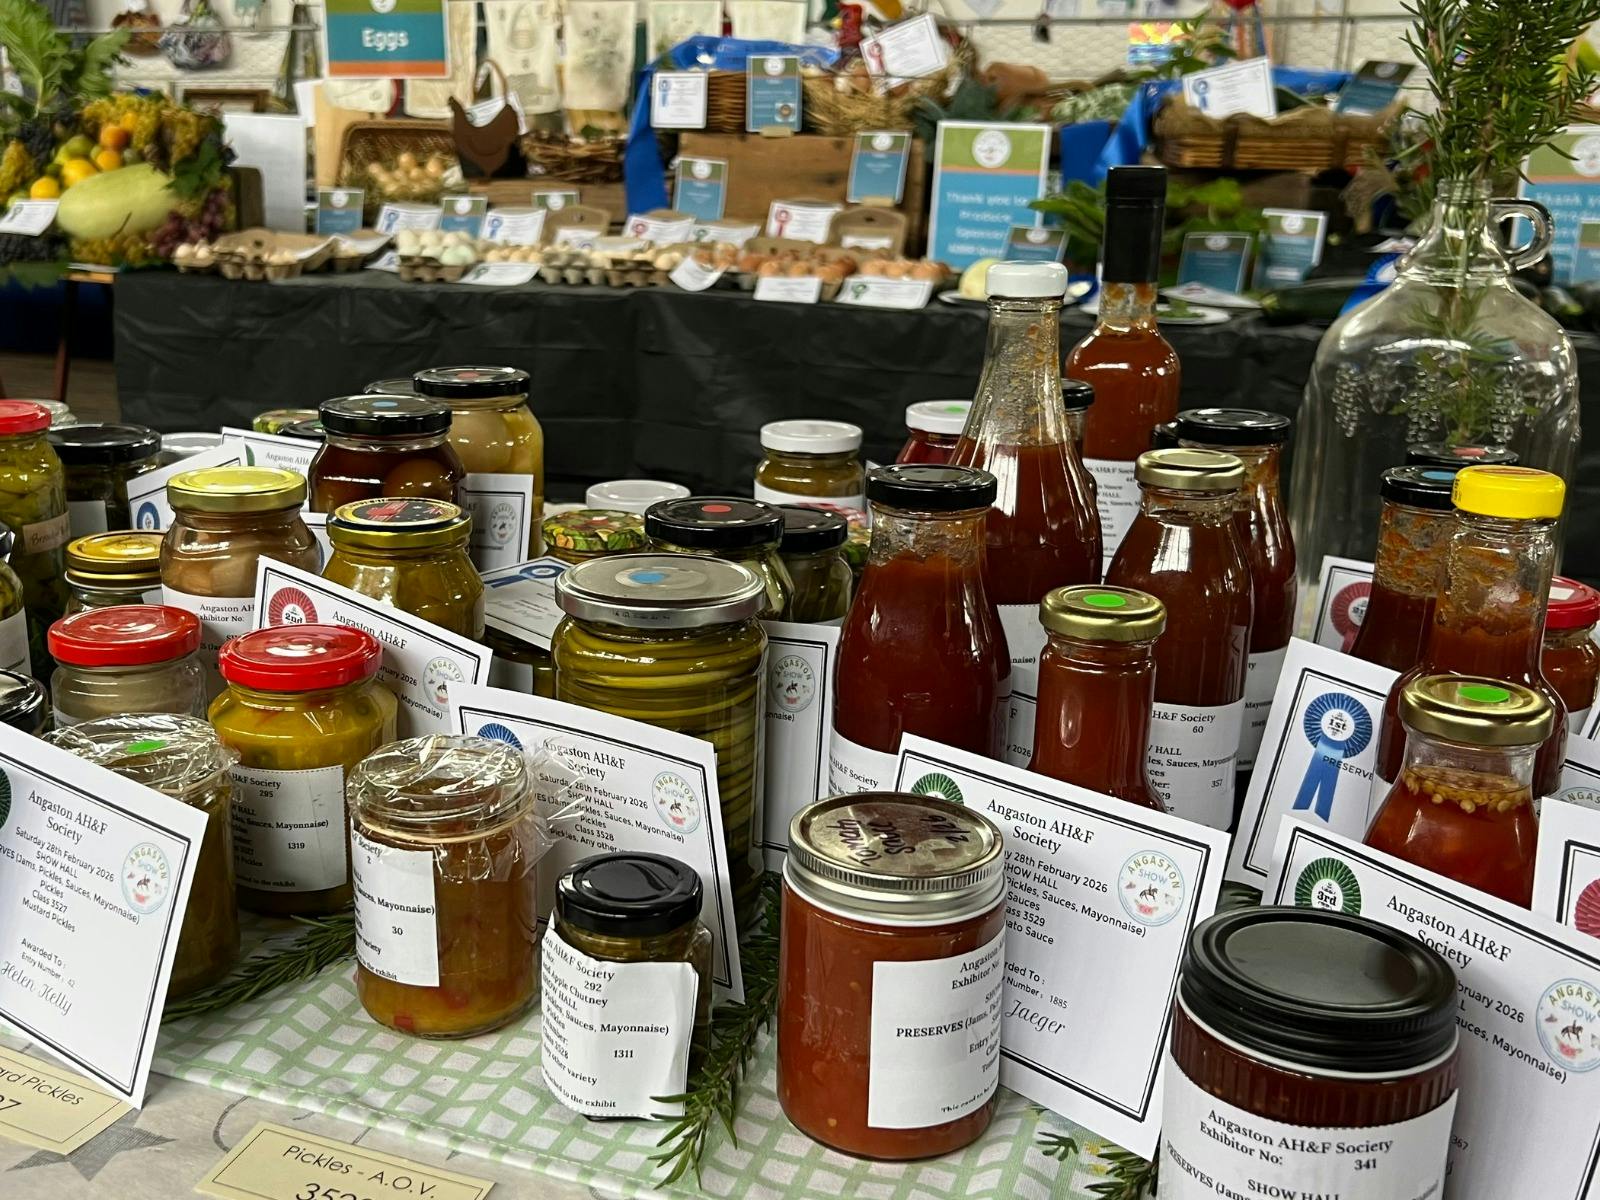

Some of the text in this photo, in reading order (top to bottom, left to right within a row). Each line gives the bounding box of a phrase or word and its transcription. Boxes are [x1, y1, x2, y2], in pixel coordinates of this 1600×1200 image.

[361, 28, 409, 51] Eggs
[199, 604, 255, 613] Angaston AH
[199, 614, 229, 622] xhibitor
[283, 613, 304, 624] 2nd
[331, 610, 408, 650] Angaston AH&F
[400, 672, 418, 687] 2026
[429, 660, 461, 680] ANGASTO
[774, 658, 812, 682] ANGASTON
[400, 693, 443, 720] Mayonnaise)
[1180, 713, 1216, 723] Society
[1192, 725, 1204, 734] 60
[1328, 718, 1348, 731] 1st
[542, 739, 626, 770] Angaston AH&F
[1012, 743, 1032, 757] 2026
[1155, 745, 1182, 756] HALL
[567, 757, 606, 782] Society
[1166, 759, 1200, 769] Sauces,
[250, 777, 282, 789] Society
[655, 776, 695, 802] ANGASTON
[849, 769, 879, 788] Society
[259, 789, 274, 798] 295
[567, 789, 615, 810] SHOW HALL
[575, 781, 593, 794] 28th
[594, 786, 628, 805] February
[629, 797, 649, 810] 2026
[28, 789, 109, 836] Angaston AH&F
[580, 814, 607, 829] Pickles
[986, 797, 1095, 845] Angaston AH&F
[46, 816, 84, 846] Society
[275, 819, 329, 832] Mayonnaise)
[575, 823, 615, 842] Class 3528
[604, 811, 634, 828] Sauces,
[635, 820, 685, 845] Mayonnaise)
[287, 842, 305, 850] 1319
[580, 836, 596, 848] Any
[597, 842, 618, 853] other
[1011, 824, 1063, 855] Society
[15, 825, 115, 883] Saturday 28th February 2026
[36, 850, 79, 879] SHOW HALL
[128, 846, 169, 881] ANGASTON
[1014, 851, 1109, 893] 28th February 2026
[1033, 872, 1059, 890] HALL
[1127, 856, 1180, 889] ANGASTON
[1138, 869, 1168, 886] SHOW
[15, 852, 141, 926] (Jams, Pickles, Sauces, Mayonnaise)
[40, 879, 64, 899] Pickles
[1007, 890, 1041, 911] Sauces
[1316, 890, 1337, 907] 3rd
[32, 889, 69, 914] Class 3527
[377, 896, 435, 916] Mayonnaise)
[22, 896, 76, 933] Mustard Pickles
[1022, 910, 1046, 927] 3529
[1041, 890, 1079, 912] Sauces,
[1080, 903, 1148, 938] Mayonnaise)
[391, 926, 404, 936] 30
[1025, 926, 1055, 946] Sauce
[1386, 894, 1513, 963] Angaston AH&F
[21, 937, 63, 967] Awarded To
[960, 944, 999, 973] Angaston
[1417, 928, 1473, 970] Society
[21, 951, 37, 968] Entry
[37, 959, 62, 979] Number
[553, 943, 576, 966] AH&F
[576, 960, 615, 982] Society
[1004, 960, 1041, 983] rded To
[0, 960, 74, 1016] Helen Kelly
[583, 980, 602, 992] 292
[951, 966, 991, 990] Exhibitor
[558, 990, 578, 1011] HALL
[569, 985, 609, 1009] Chutney
[1006, 975, 1068, 1010] Number 1885
[565, 1009, 597, 1033] Sauces,
[600, 1023, 670, 1037] Mayonnaise)
[1004, 998, 1066, 1036] Jaeger
[1495, 1000, 1526, 1024] 2026
[1560, 1000, 1597, 1024] SHOW
[896, 1010, 988, 1039] PRESERVES (Jams,
[613, 1049, 634, 1058] 1311
[969, 1034, 990, 1054] Entry
[1455, 1015, 1568, 1085] auces, Mayonnaise)
[567, 1067, 598, 1086] variety
[22, 1075, 85, 1106] Pickles
[570, 1094, 583, 1105] the
[585, 1099, 617, 1108] exhibit
[1207, 1109, 1394, 1155] Angaston AH&F Society
[1199, 1121, 1378, 1172] Exhibitor No: 341
[282, 1144, 436, 1200] Pickles A.O.V.
[1166, 1139, 1214, 1189] PRESERVES
[1247, 1178, 1297, 1200] SHOW
